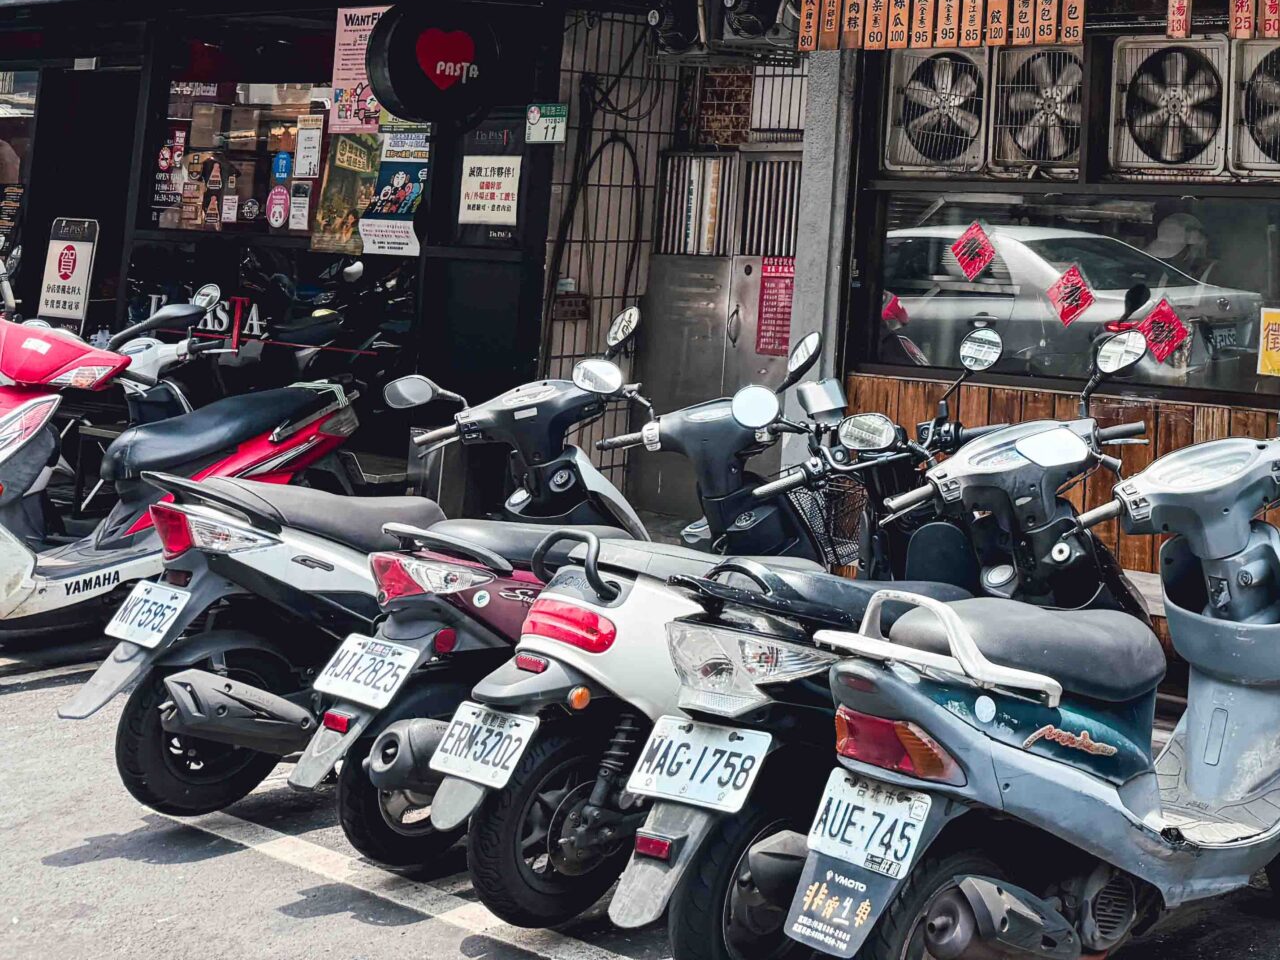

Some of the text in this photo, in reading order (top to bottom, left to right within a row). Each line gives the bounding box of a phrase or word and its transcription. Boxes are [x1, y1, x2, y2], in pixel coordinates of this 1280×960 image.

[1235, 17, 1251, 30] 25
[1264, 19, 1280, 32] 50
[941, 28, 955, 39] 95
[965, 29, 978, 40] 85
[990, 27, 1003, 38] 120
[1016, 27, 1030, 38] 140
[1039, 25, 1052, 36] 85
[1065, 26, 1079, 37] 85
[801, 36, 812, 47] 80
[869, 32, 882, 42] 60
[890, 31, 904, 42] 100
[915, 32, 928, 42] 95
[436, 60, 479, 84] PASTA
[543, 125, 557, 140] 11
[61, 249, 75, 277] 賀
[64, 569, 120, 596] YAMAHA
